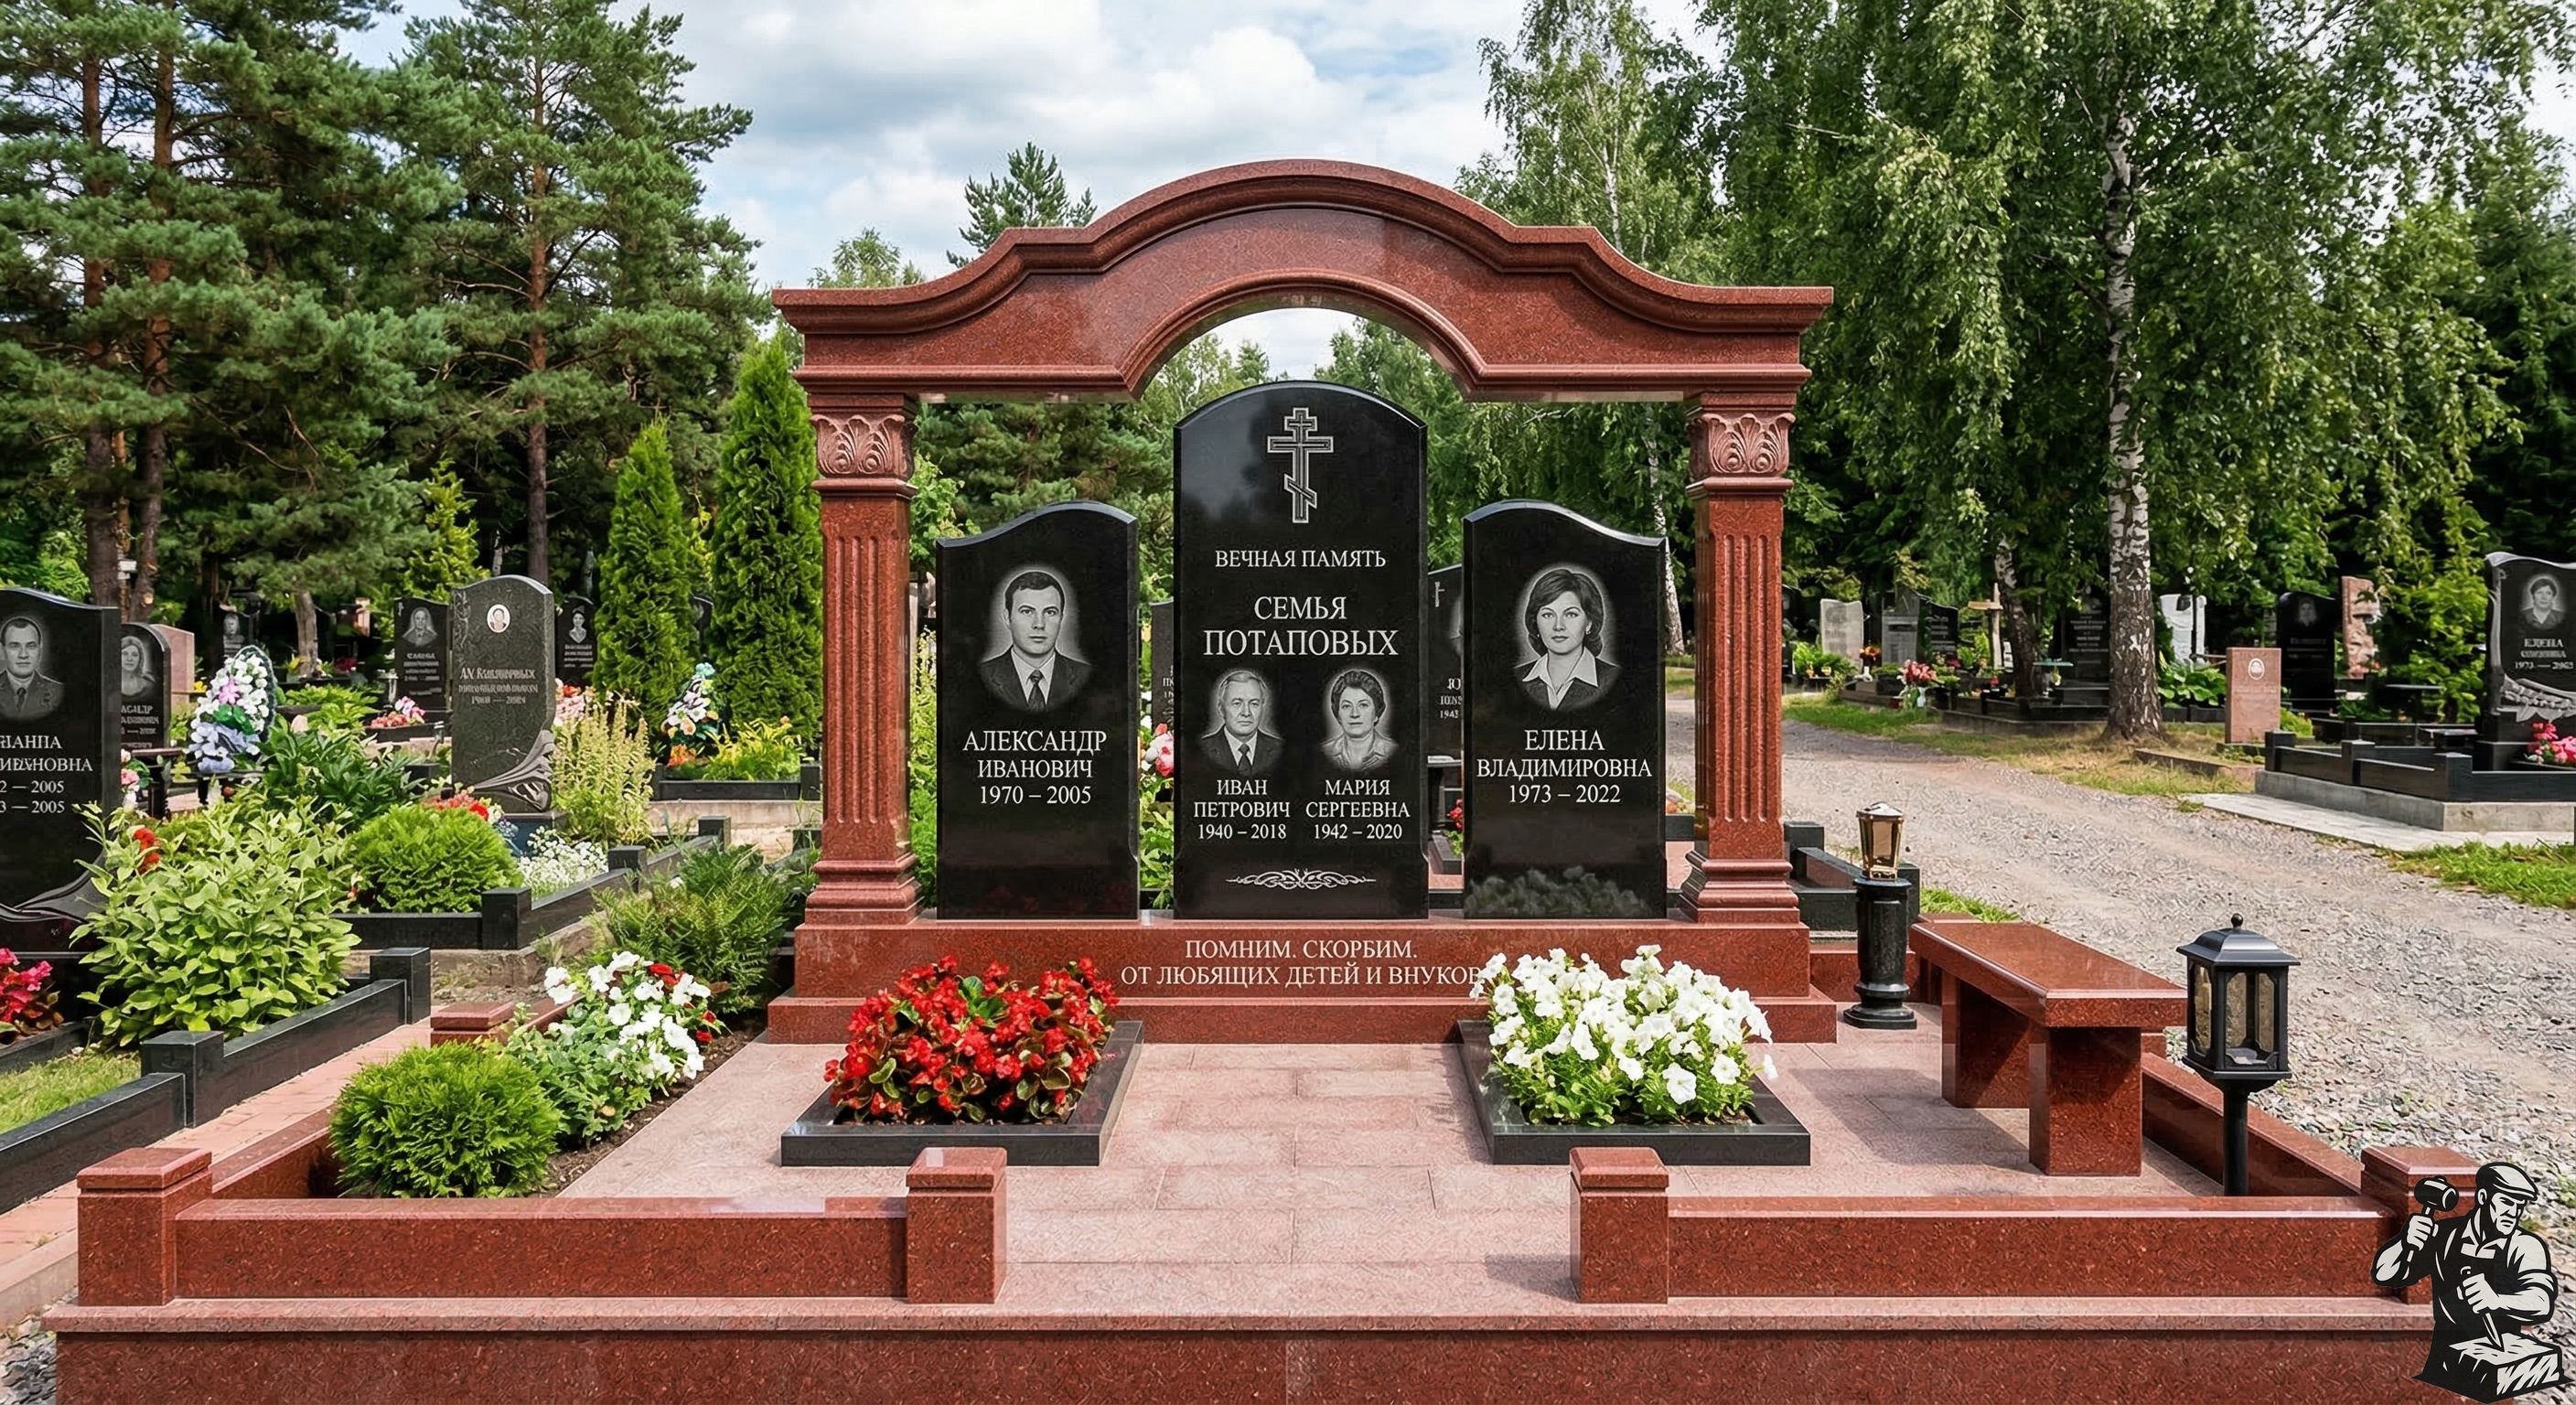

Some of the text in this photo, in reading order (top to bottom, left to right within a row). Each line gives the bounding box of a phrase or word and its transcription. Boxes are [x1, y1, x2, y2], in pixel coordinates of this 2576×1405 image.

[1215, 550, 1387, 567] ВЕЧНАЯ ПАМЯТЬ
[1254, 595, 1347, 620] СЕМЬЯ
[1203, 629, 1399, 656] ПОТАПОВЫХ
[962, 730, 1107, 756] АЛЕКСАНДР
[1524, 729, 1605, 751] ЕЛЕНА
[977, 759, 1093, 778] ИВАНОВИЧ
[1476, 758, 1653, 781] ВЛАДИМИРОВНА
[30, 780, 64, 793] 2005
[981, 785, 1024, 805] 1970
[1046, 785, 1091, 805] 2005
[1217, 779, 1268, 796] ИВАН
[1325, 779, 1390, 796] МАРИЯ
[1509, 784, 1551, 803] 1973
[1575, 784, 1621, 803] 2022
[31, 800, 65, 813] 2005
[1193, 801, 1291, 818] ПЕТРОВИЧ
[1305, 801, 1411, 818] СЕРГЕЕВНА
[1198, 823, 1233, 840] 1940
[1250, 823, 1287, 840] 2018
[1315, 823, 1348, 840] 1942
[1366, 823, 1402, 840] 2020
[1185, 939, 1418, 959] ПОМНИМ. СКОРБИМ.
[1121, 966, 1153, 985] ОТ
[1156, 966, 1281, 989] ЛЮБЯЩИХ
[1284, 960, 1360, 988] ДЕТЕЙ
[1365, 966, 1382, 985] И
